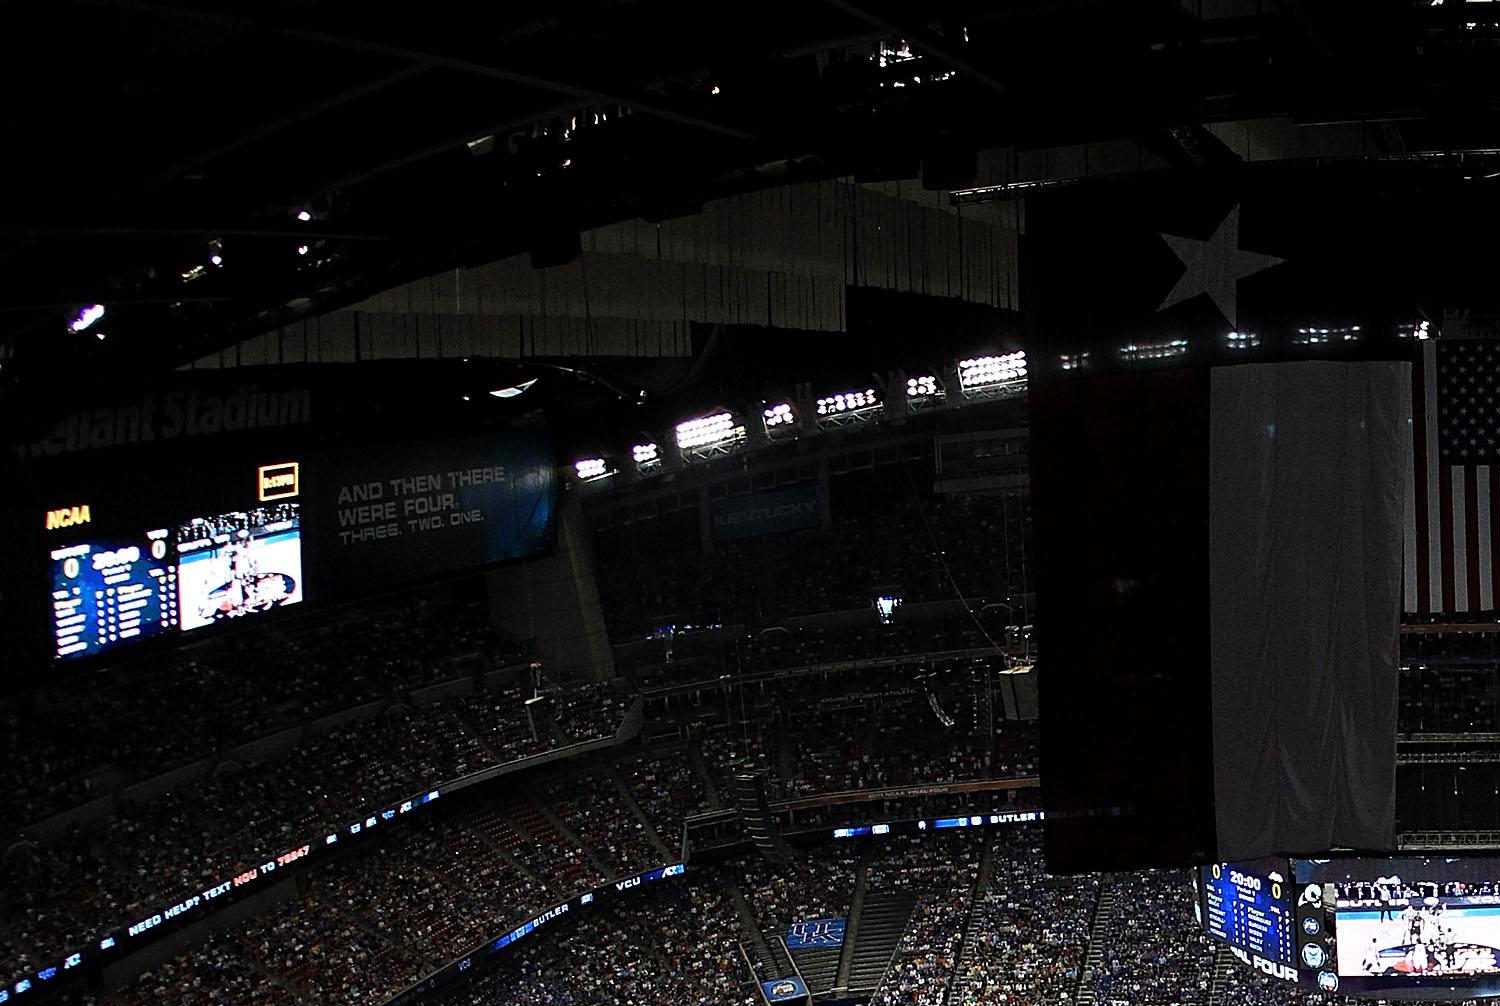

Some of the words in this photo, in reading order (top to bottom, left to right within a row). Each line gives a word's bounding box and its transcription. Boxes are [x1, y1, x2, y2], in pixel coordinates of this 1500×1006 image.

[338, 481, 382, 505] AND
[390, 474, 441, 496] THEN
[448, 466, 505, 489] THERE
[47, 505, 90, 529] NCAA
[338, 501, 397, 527] WERE
[404, 493, 459, 516] FOUR.
[990, 812, 1036, 824] BUTLER
[1213, 863, 1221, 879] 0
[1230, 870, 1261, 891] 20:00
[616, 877, 641, 891] VCU
[1271, 883, 1281, 899] 0
[128, 914, 161, 936] NEED
[164, 896, 200, 919] HELP?
[202, 881, 232, 900] TEXT
[233, 868, 257, 886] HOU
[260, 861, 275, 874] TO
[533, 904, 569, 928] BUTLER
[1253, 954, 1299, 983] FOUR
